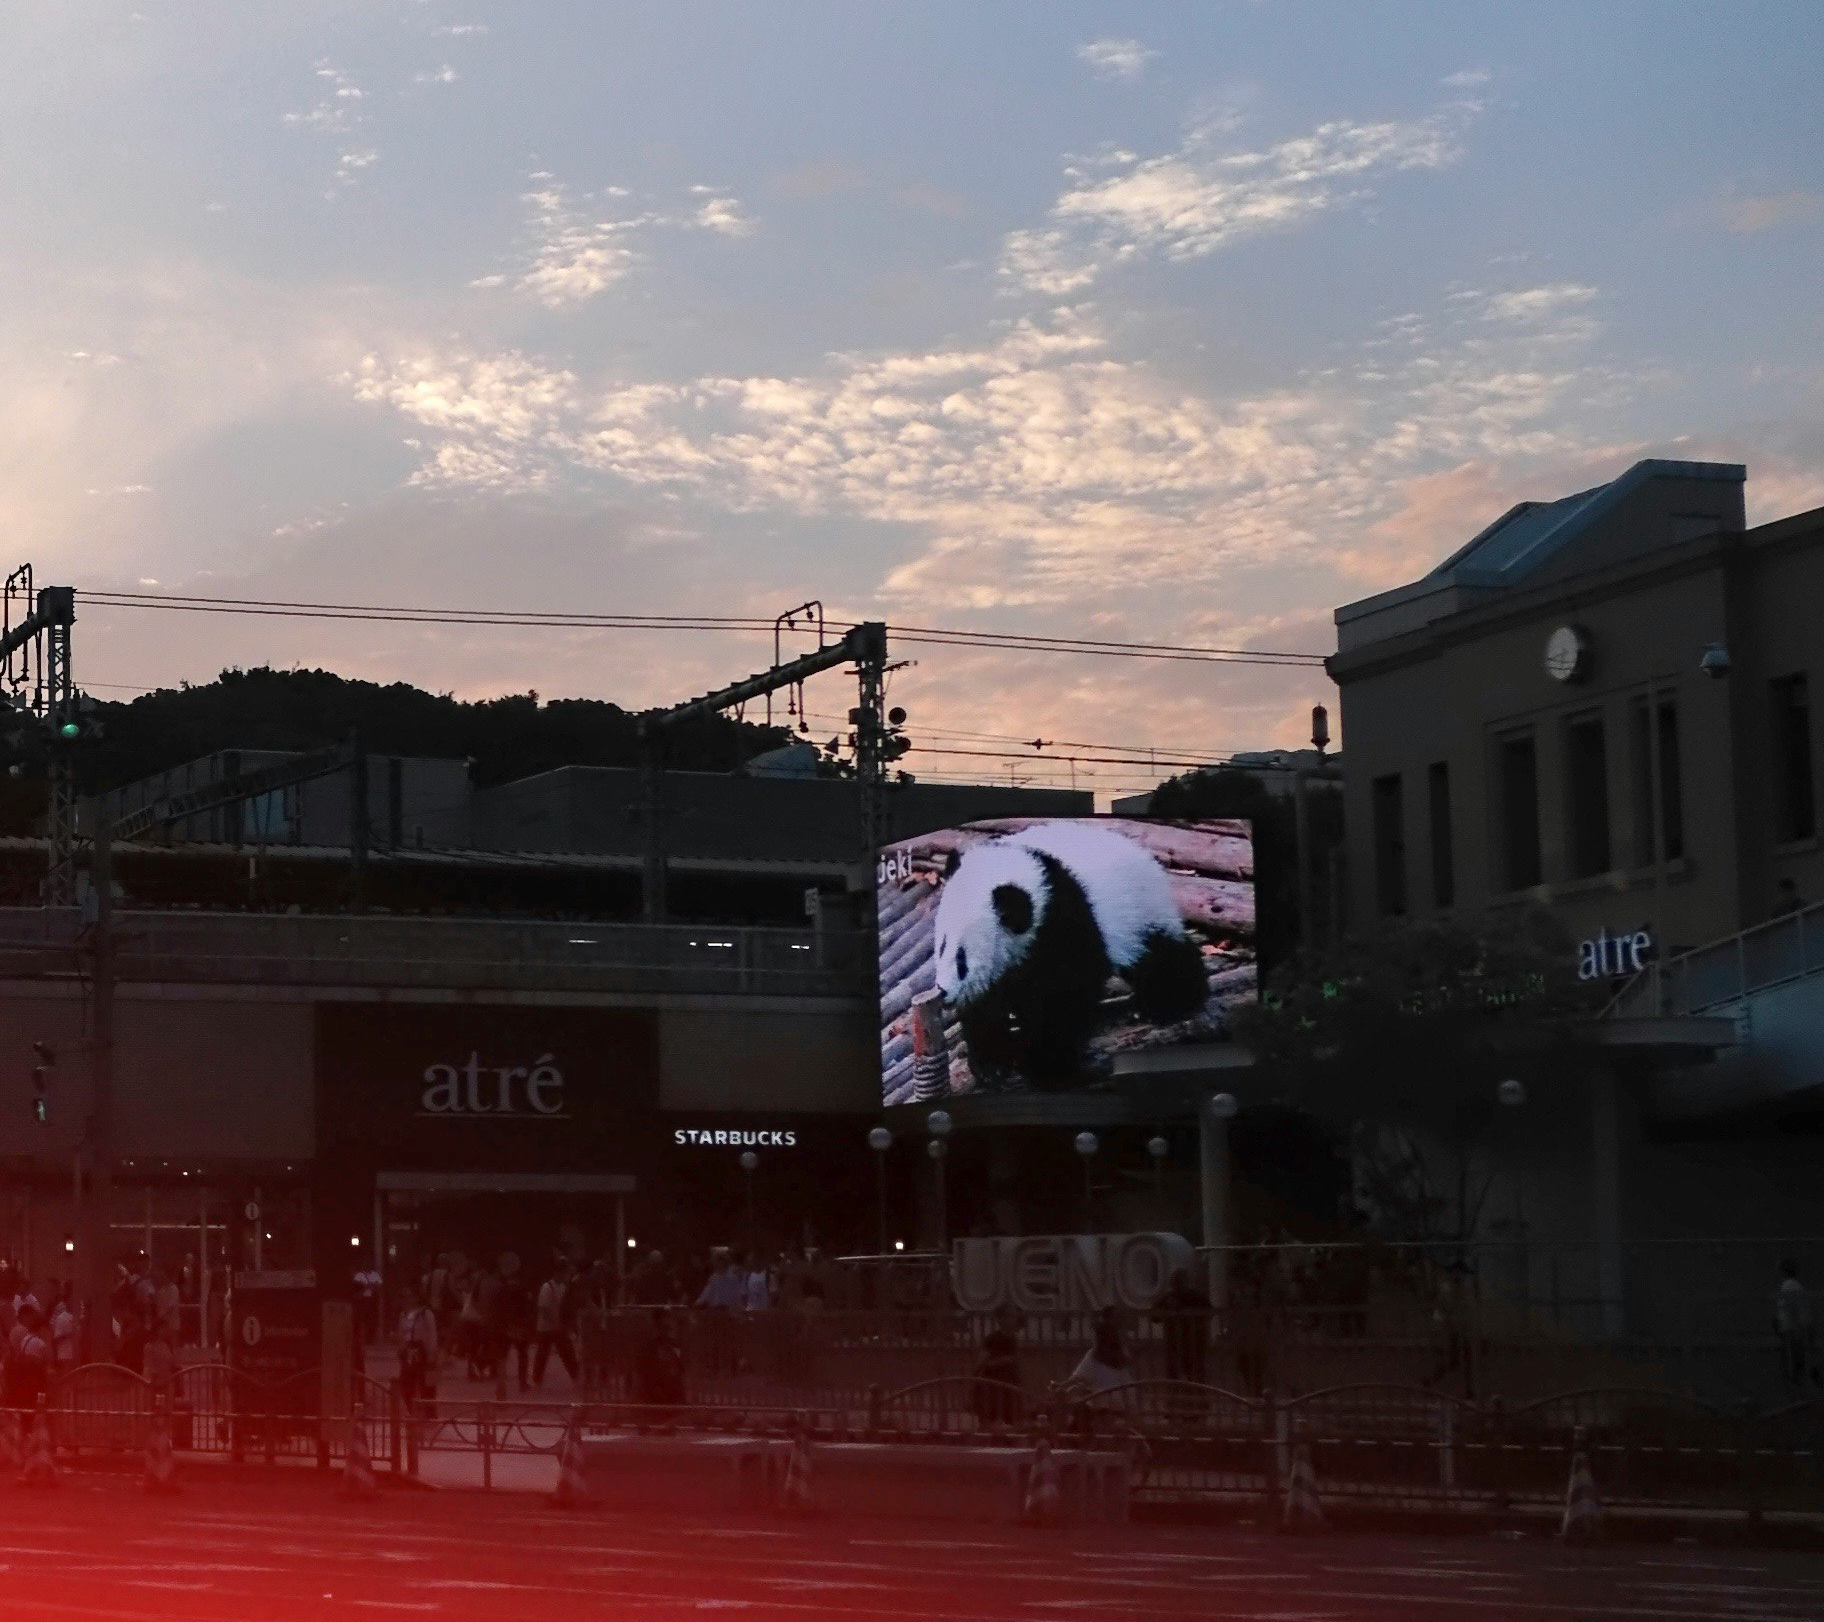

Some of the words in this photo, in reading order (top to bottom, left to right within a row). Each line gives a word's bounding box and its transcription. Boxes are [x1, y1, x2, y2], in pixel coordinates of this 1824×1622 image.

[877, 845, 912, 883] jeki
[422, 1051, 564, 1113] atré
[675, 1128, 797, 1147] STARBUCKS
[951, 1234, 1176, 1311] UENO
